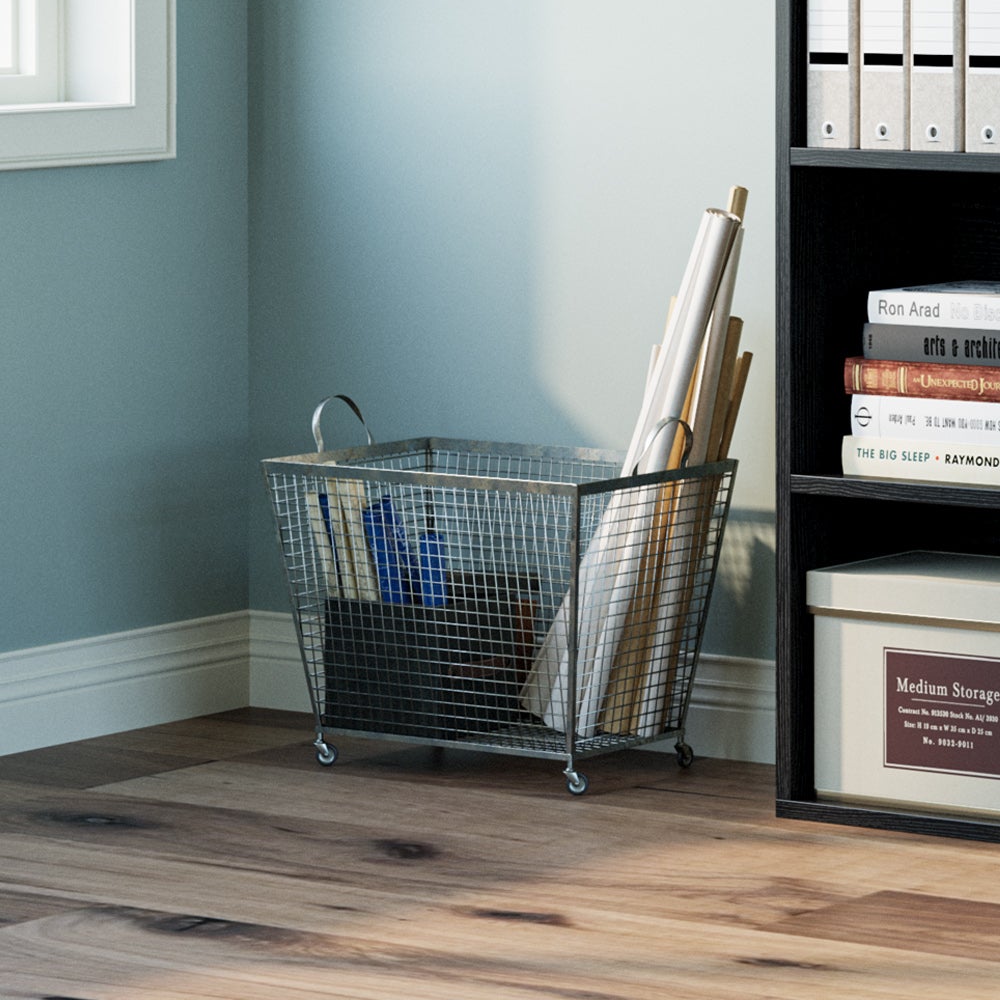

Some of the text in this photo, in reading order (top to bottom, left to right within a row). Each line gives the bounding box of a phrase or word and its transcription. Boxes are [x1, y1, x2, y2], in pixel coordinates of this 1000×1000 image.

[878, 300, 940, 318] Ron Arad
[950, 302, 969, 320] No
[924, 335, 945, 356] arts
[920, 374, 978, 392] UNEXPECTED
[942, 418, 956, 428] WANT
[856, 448, 930, 462] THE BIG SLEEP
[944, 454, 1000, 468] RAYMOND
[896, 677, 1000, 706] Medium Storage
[944, 724, 950, 732] W
[922, 736, 935, 745] No.
